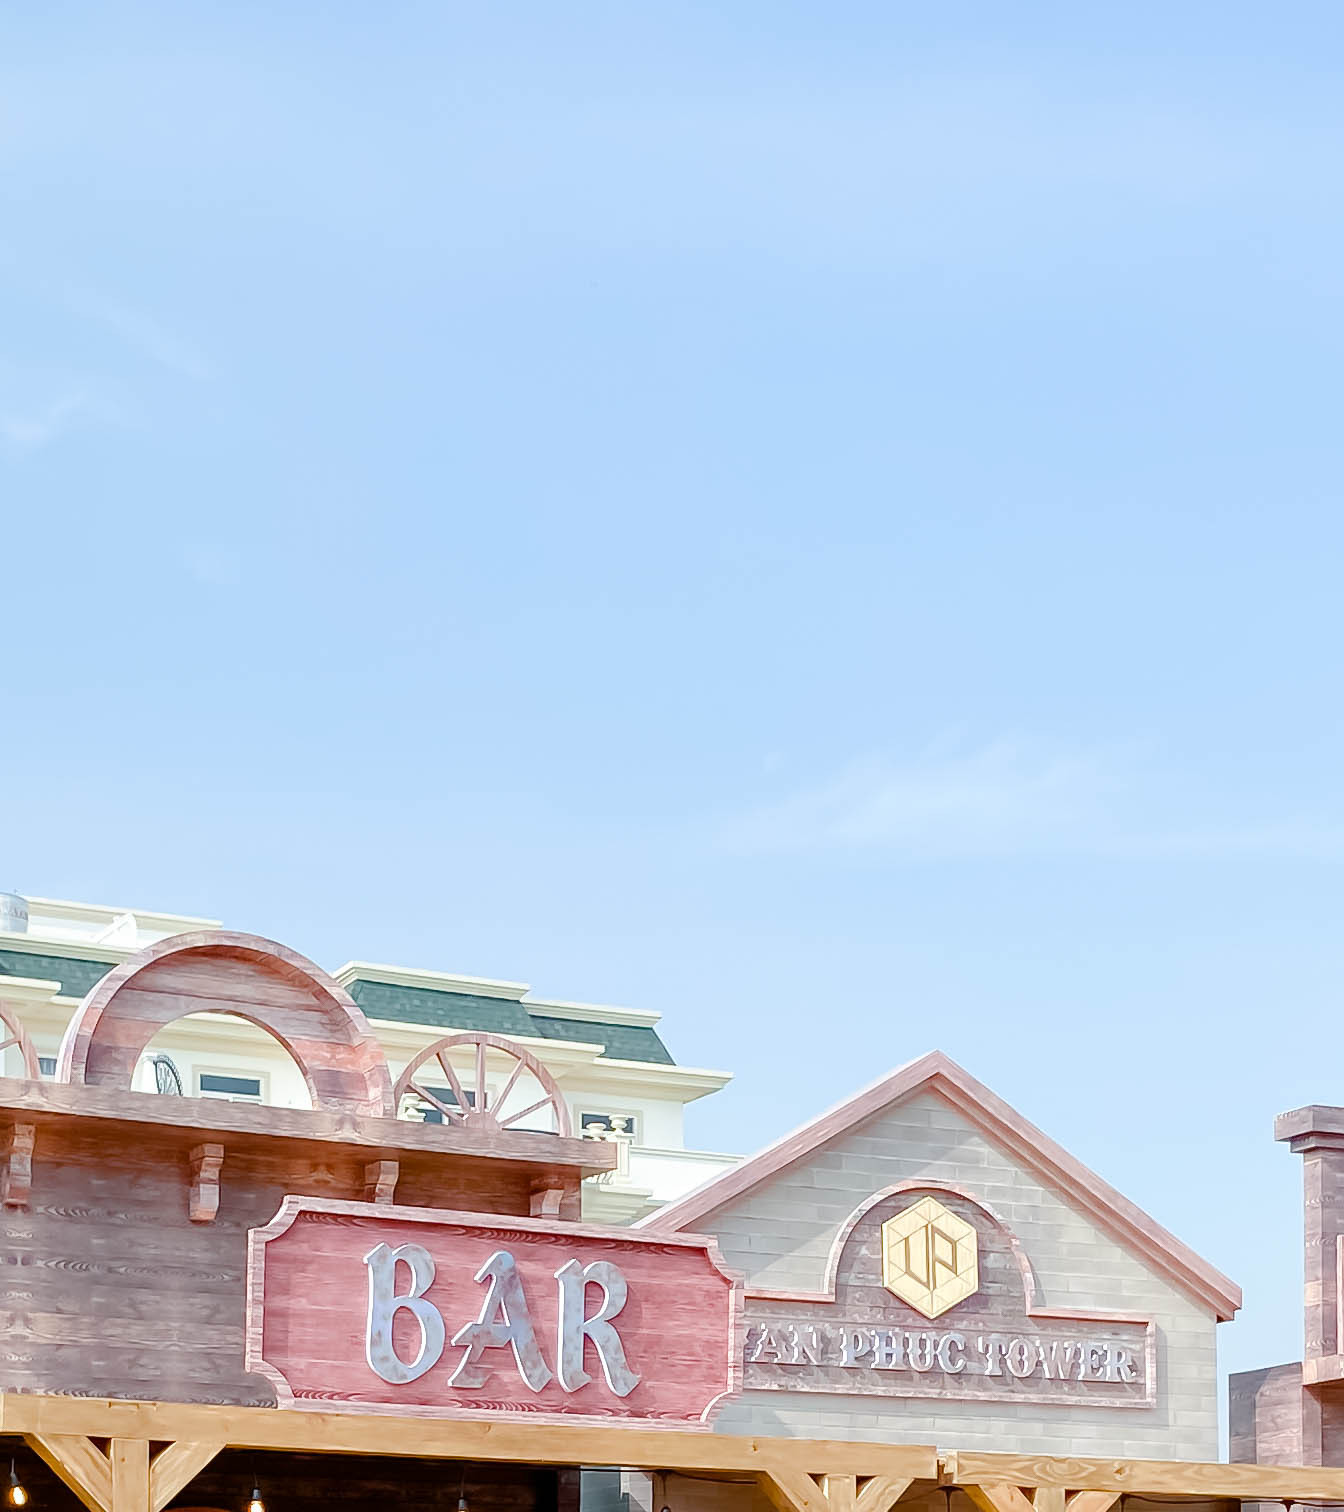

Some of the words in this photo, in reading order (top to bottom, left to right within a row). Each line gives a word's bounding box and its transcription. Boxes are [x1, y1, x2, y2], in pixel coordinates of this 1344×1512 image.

[363, 1242, 641, 1397] BAR
[750, 1323, 823, 1365] AN
[840, 1327, 967, 1374] PHUC
[978, 1334, 1137, 1382] TOWER
